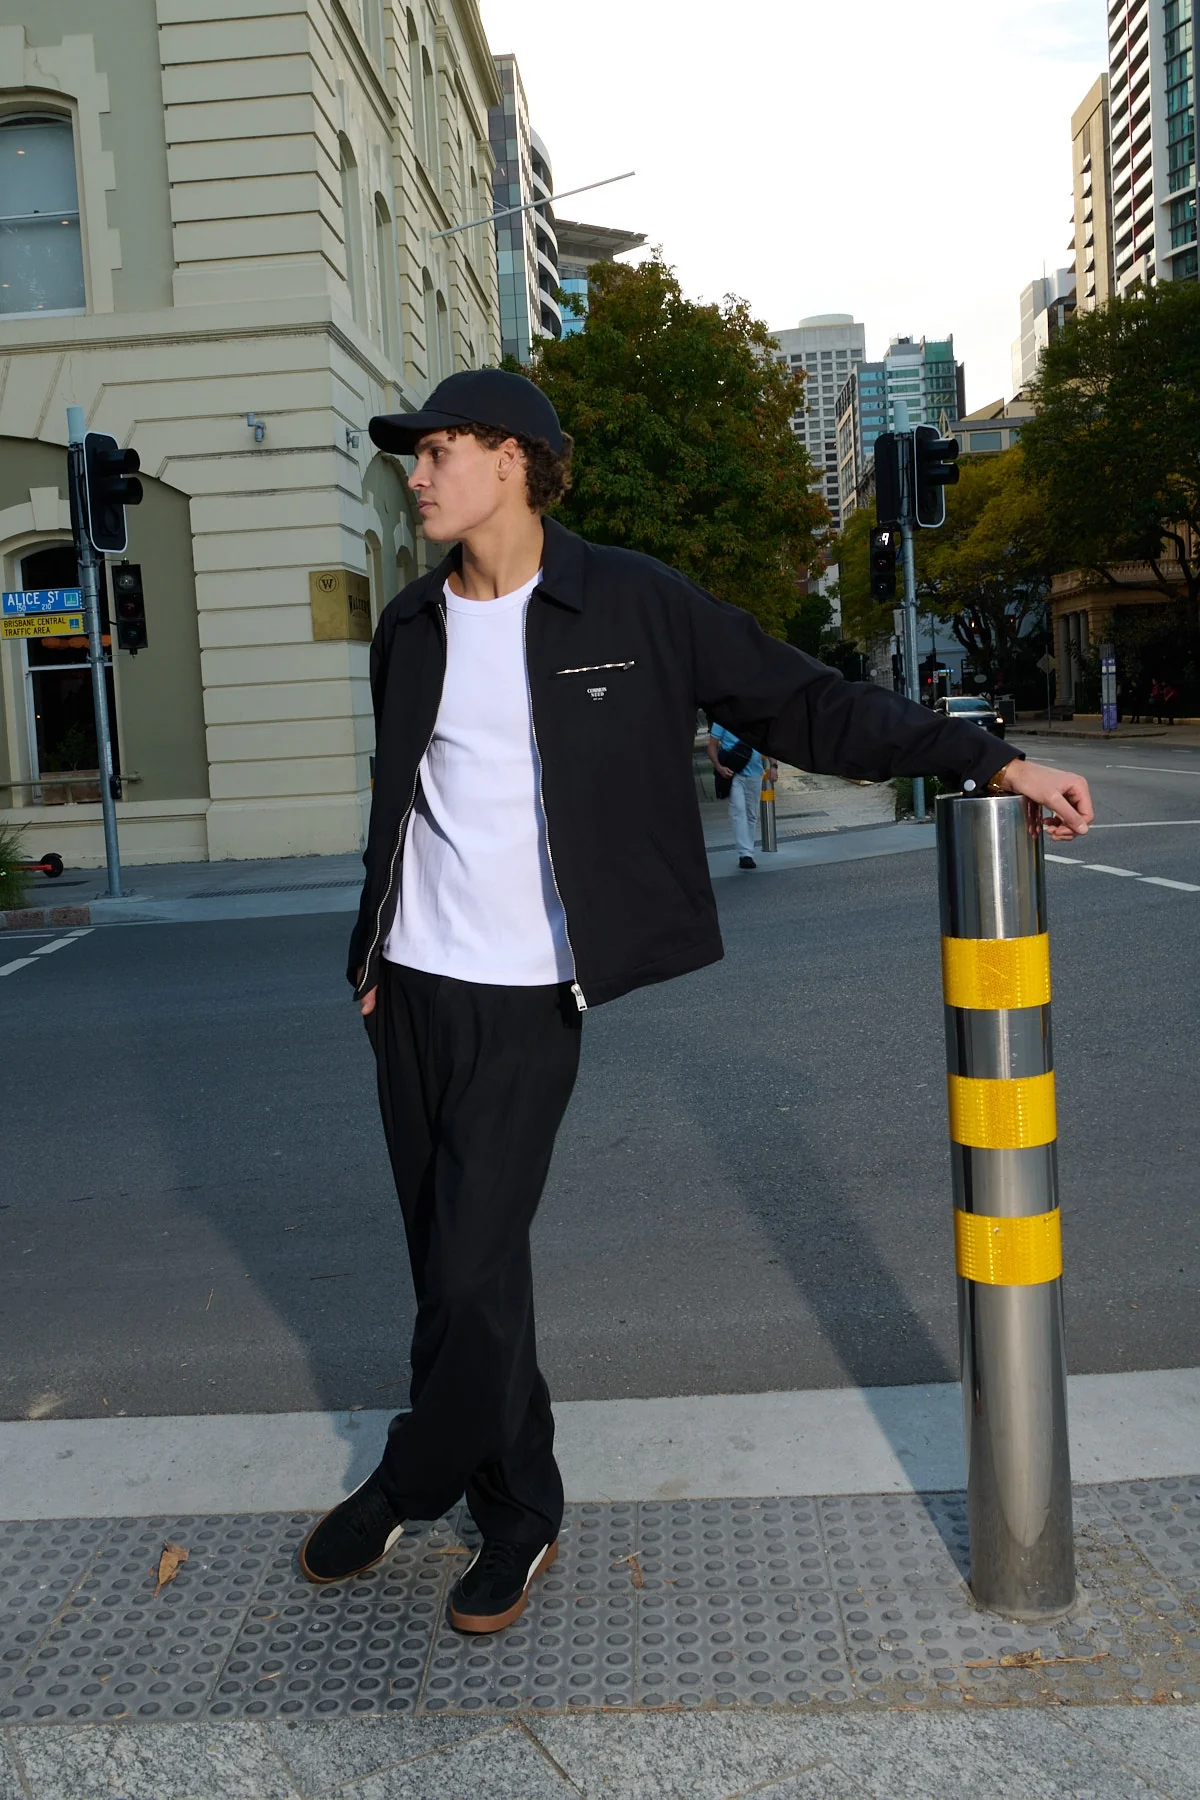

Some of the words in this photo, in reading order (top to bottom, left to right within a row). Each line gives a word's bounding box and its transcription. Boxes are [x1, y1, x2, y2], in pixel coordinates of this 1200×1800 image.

[882, 533, 889, 545] 9
[321, 579, 333, 589] W
[8, 592, 40, 606] ALICE
[47, 591, 59, 604] ST
[17, 603, 26, 612] 150
[4, 617, 35, 628] BRISBANE
[38, 617, 67, 625] CENTRAL
[5, 628, 31, 636] TRAFFIC
[34, 627, 50, 635] AREA
